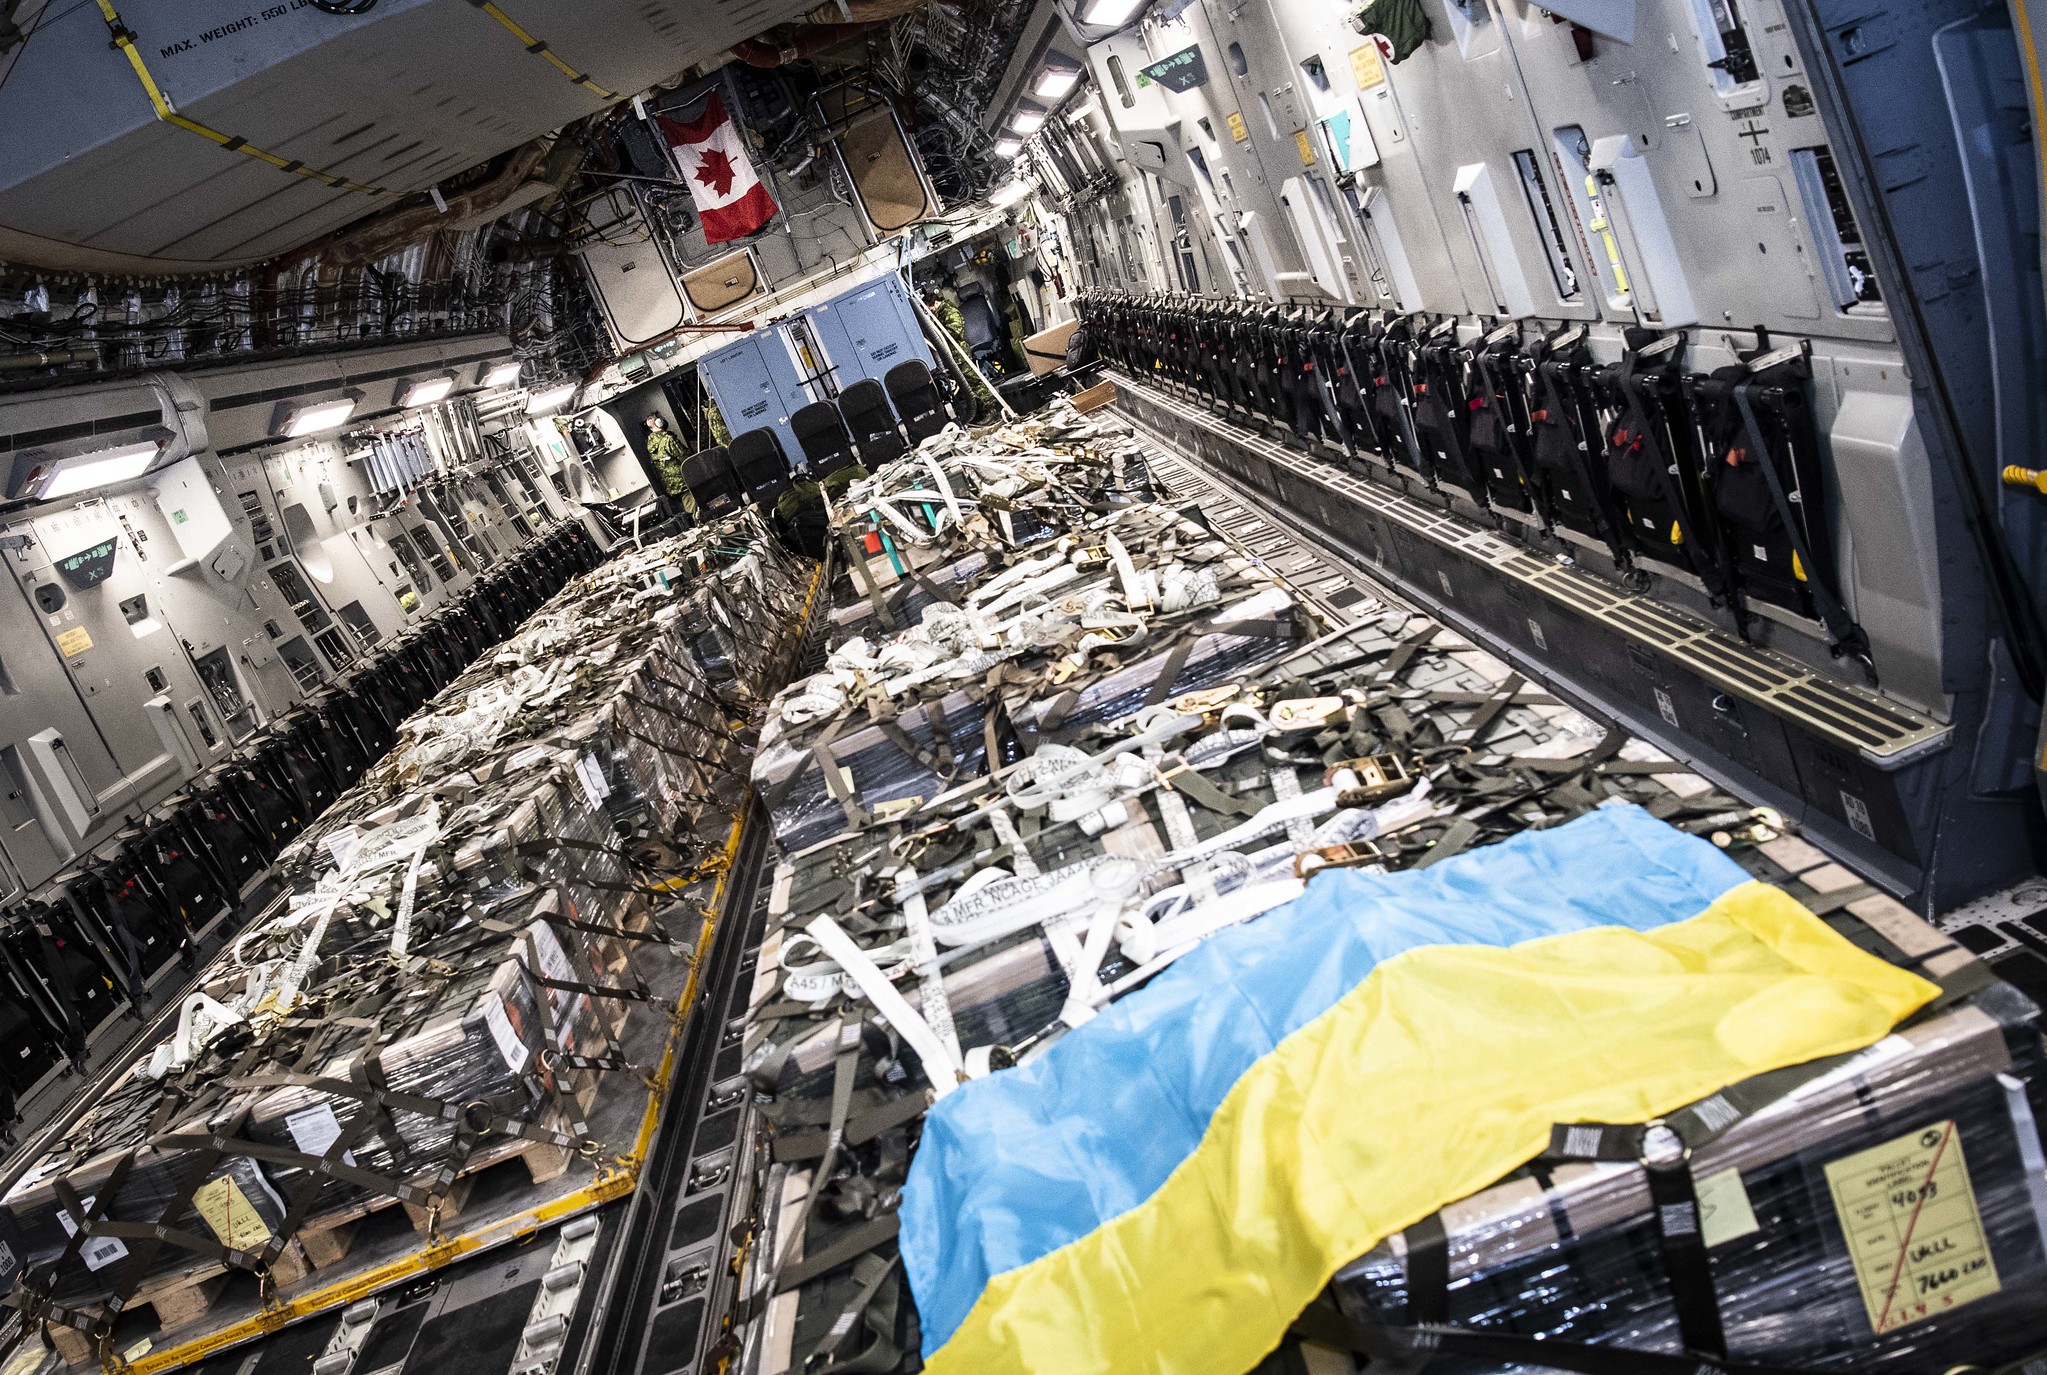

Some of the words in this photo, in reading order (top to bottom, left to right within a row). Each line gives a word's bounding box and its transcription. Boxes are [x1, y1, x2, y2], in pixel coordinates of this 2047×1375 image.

[160, 39, 197, 58] MAX.
[199, 16, 259, 44] WEIGHT:
[261, 4, 287, 21] 550
[1751, 147, 1771, 165] 1074
[991, 877, 1039, 904] NCAGE
[311, 1294, 335, 1307] Property
[341, 1282, 367, 1295] Canadian
[368, 1272, 391, 1284] National
[391, 1263, 413, 1274] Defence
[145, 1360, 163, 1370] Return
[179, 1346, 200, 1358] nearest
[199, 1336, 225, 1350] Canadian
[224, 1330, 242, 1340] Forces
[242, 1325, 256, 1333] Base
